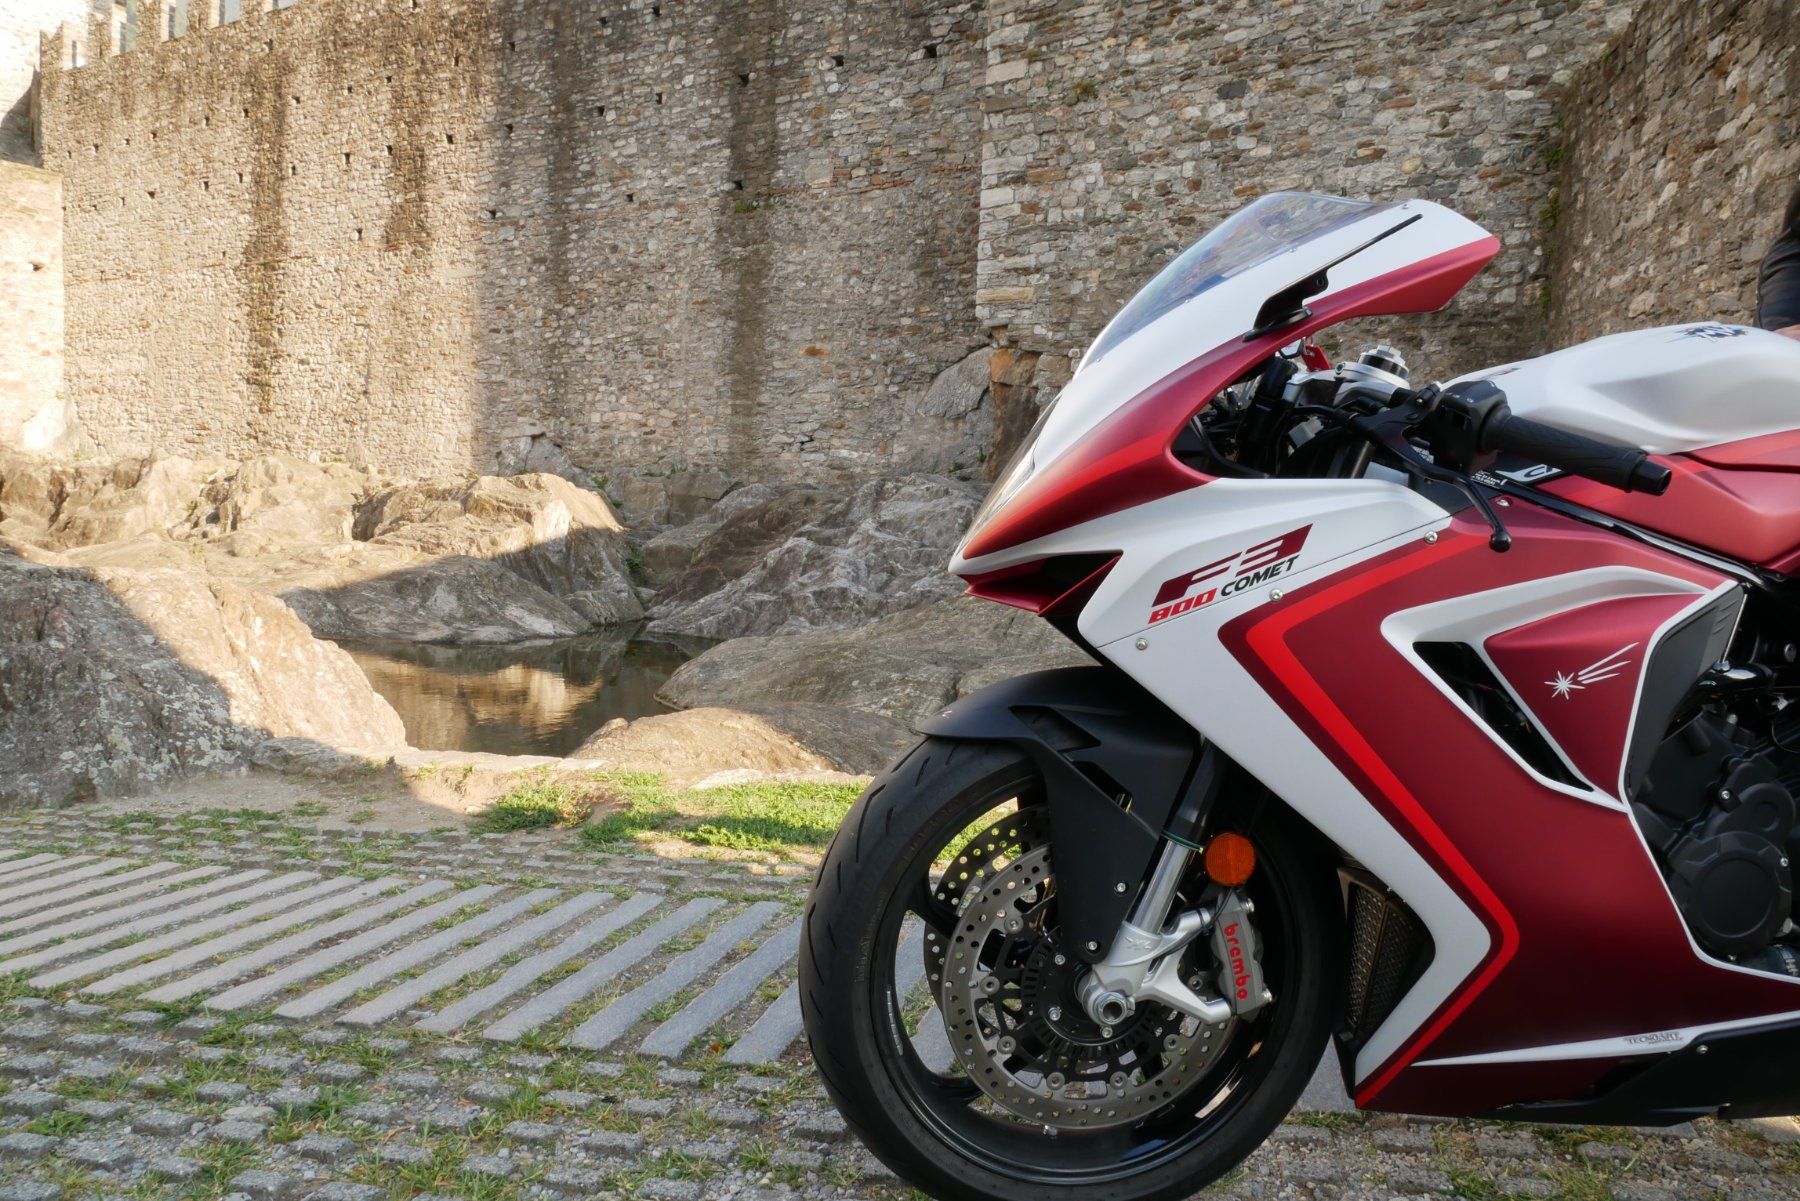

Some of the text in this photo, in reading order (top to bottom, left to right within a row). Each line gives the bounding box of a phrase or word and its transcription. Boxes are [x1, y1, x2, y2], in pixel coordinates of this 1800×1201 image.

[1148, 554, 1300, 624] 800 COMET
[1152, 523, 1313, 607] F3
[1224, 923, 1251, 1000] brembo
